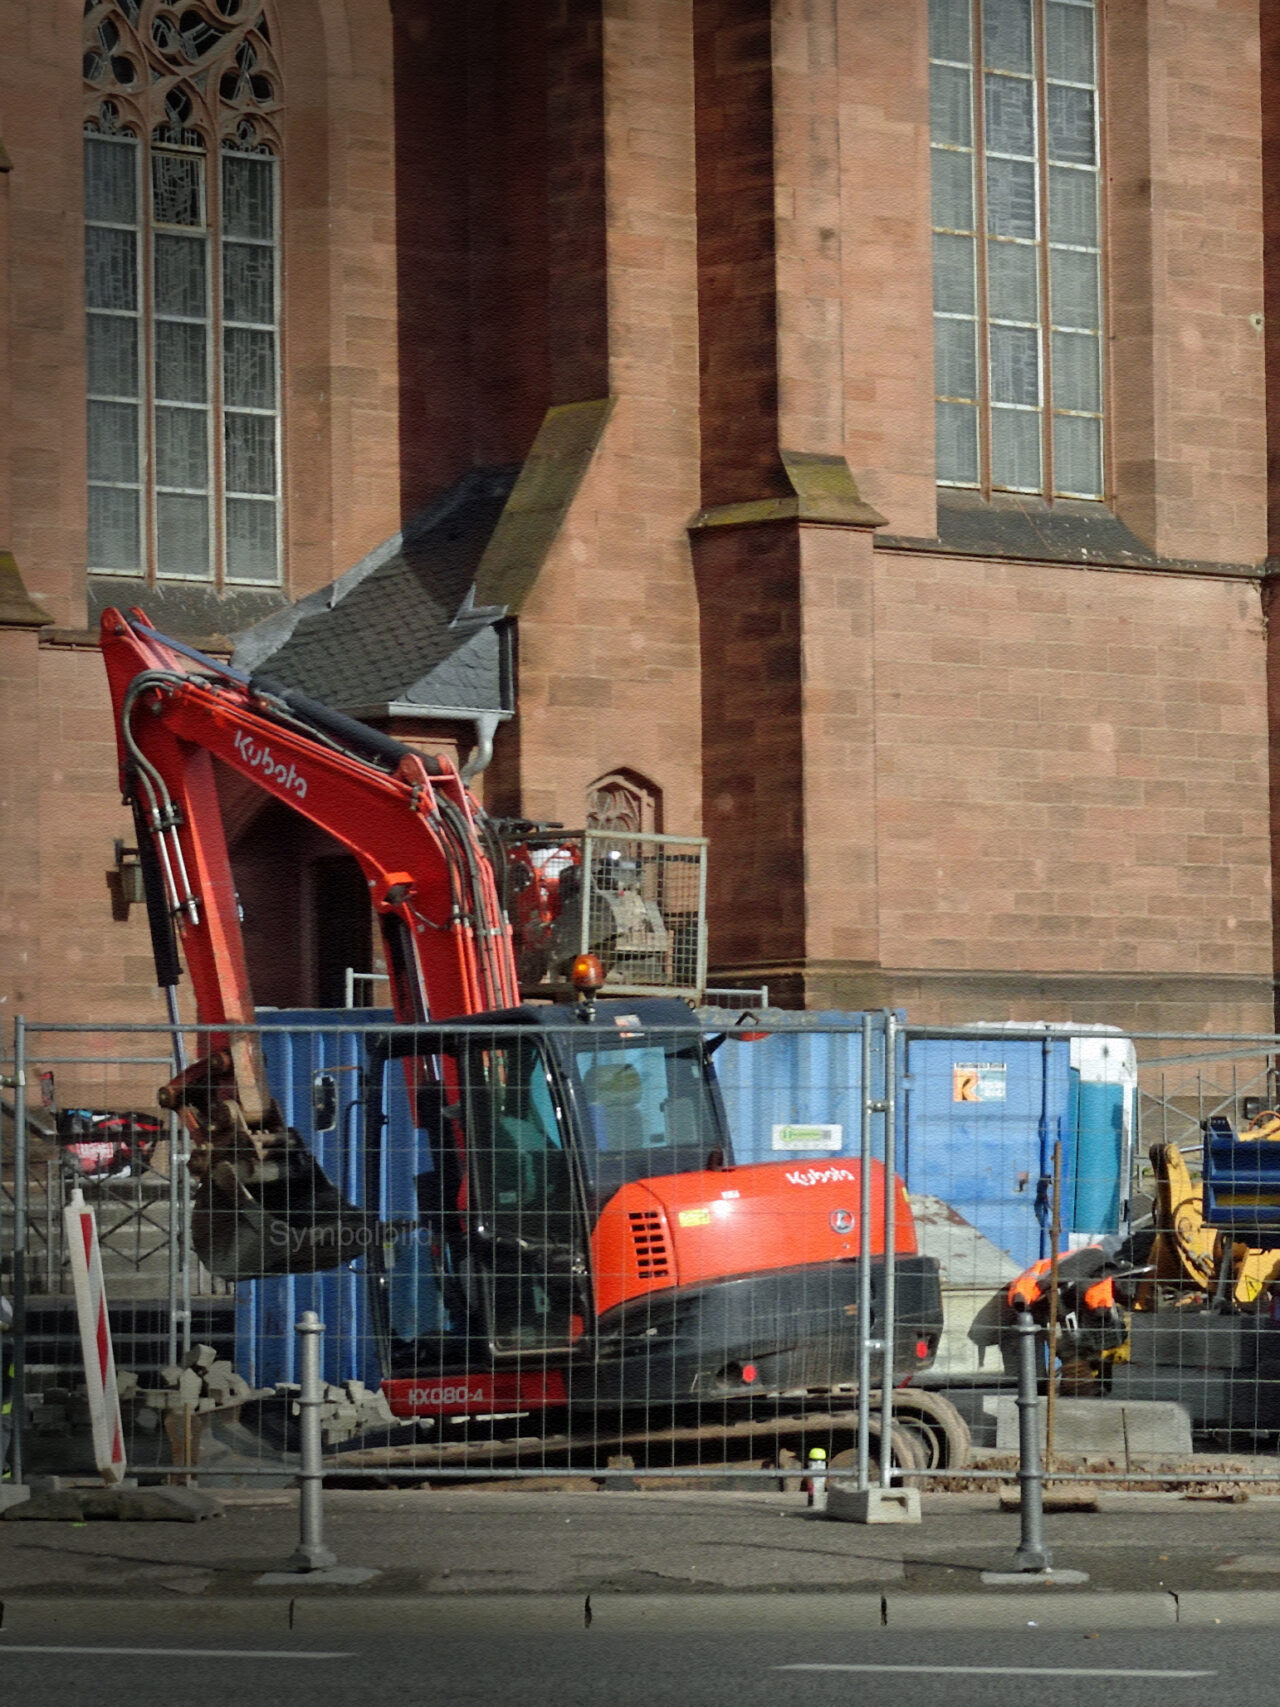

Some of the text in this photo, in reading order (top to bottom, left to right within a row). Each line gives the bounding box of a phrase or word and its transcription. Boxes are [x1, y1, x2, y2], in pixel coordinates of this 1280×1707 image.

[234, 729, 307, 798] Kubota
[785, 1166, 855, 1187] Kubota
[408, 1386, 484, 1405] KX080-4
